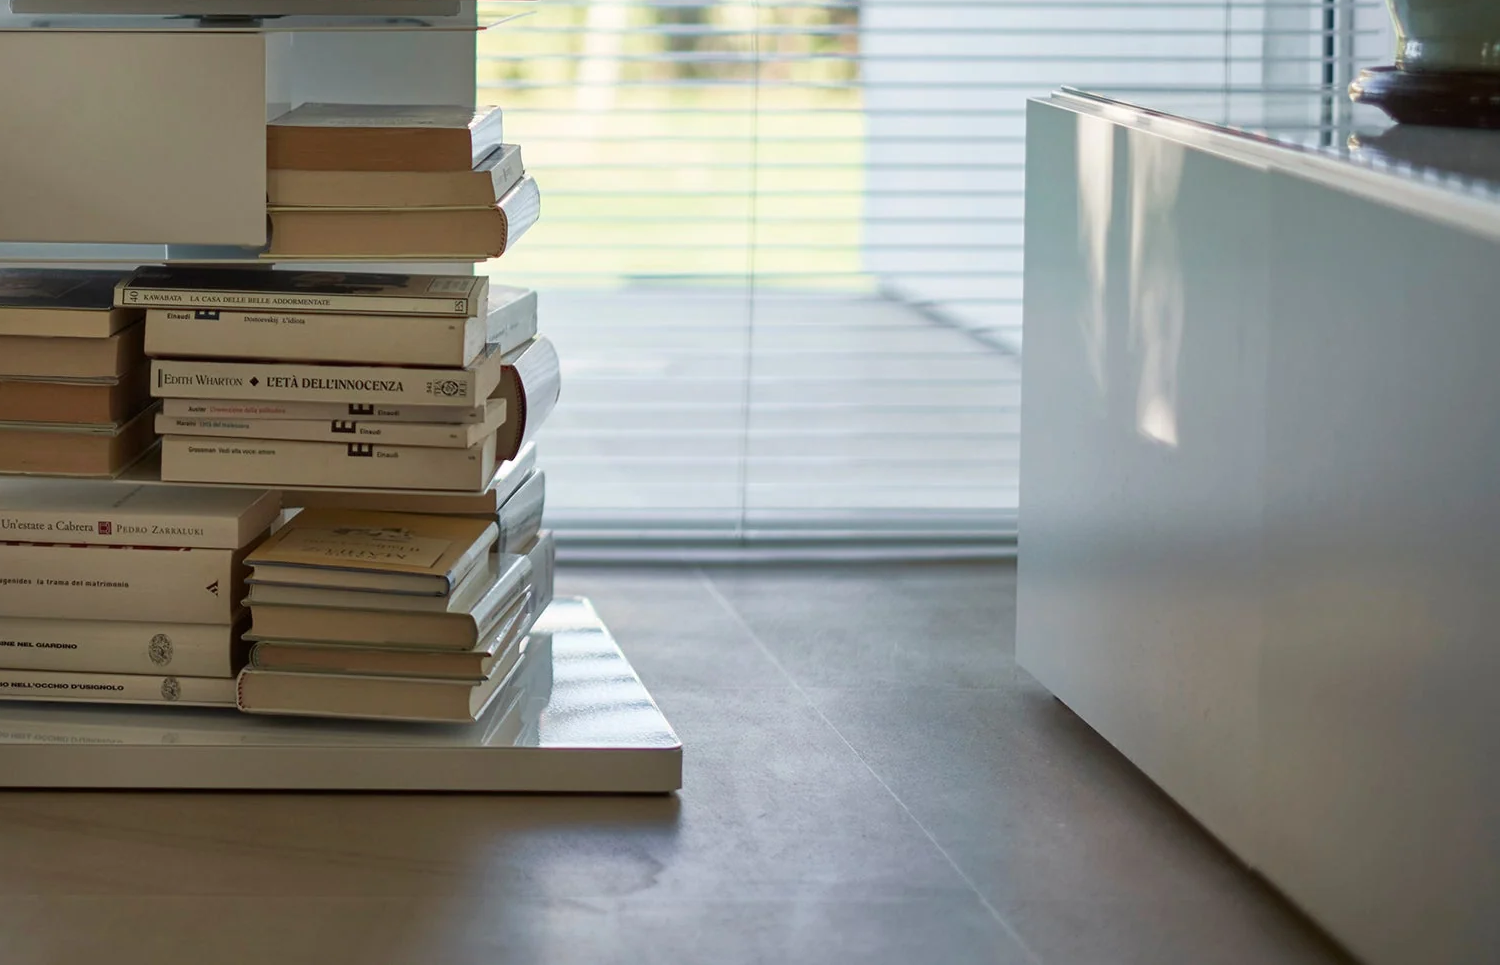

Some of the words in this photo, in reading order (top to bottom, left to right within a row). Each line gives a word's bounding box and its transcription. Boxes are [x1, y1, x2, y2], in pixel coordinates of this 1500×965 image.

[129, 290, 139, 303] 40
[143, 294, 182, 302] KAWABATA
[190, 295, 200, 303] LA
[201, 295, 221, 303] CASA
[222, 296, 247, 304] DELLE
[248, 296, 270, 305] BELLE
[272, 297, 331, 306] ADDORMENTATE
[167, 312, 191, 320] Einaudi
[244, 316, 279, 325] Dostoevskij
[266, 375, 298, 388] L'ETÀ
[301, 377, 404, 392] DELL'INNOCENZA
[359, 428, 382, 436] Einaudi
[376, 451, 399, 459] Einaudi
[1, 519, 45, 531] Un'estate
[55, 520, 94, 532] Cabrera
[116, 524, 148, 534] PEDRO
[36, 577, 44, 585] la
[46, 578, 69, 586] trama
[71, 579, 84, 587] del
[85, 579, 129, 588] matrimonio
[10, 682, 69, 690] NELL'OCCHIO
[70, 683, 125, 691] D'USIGNOLO
